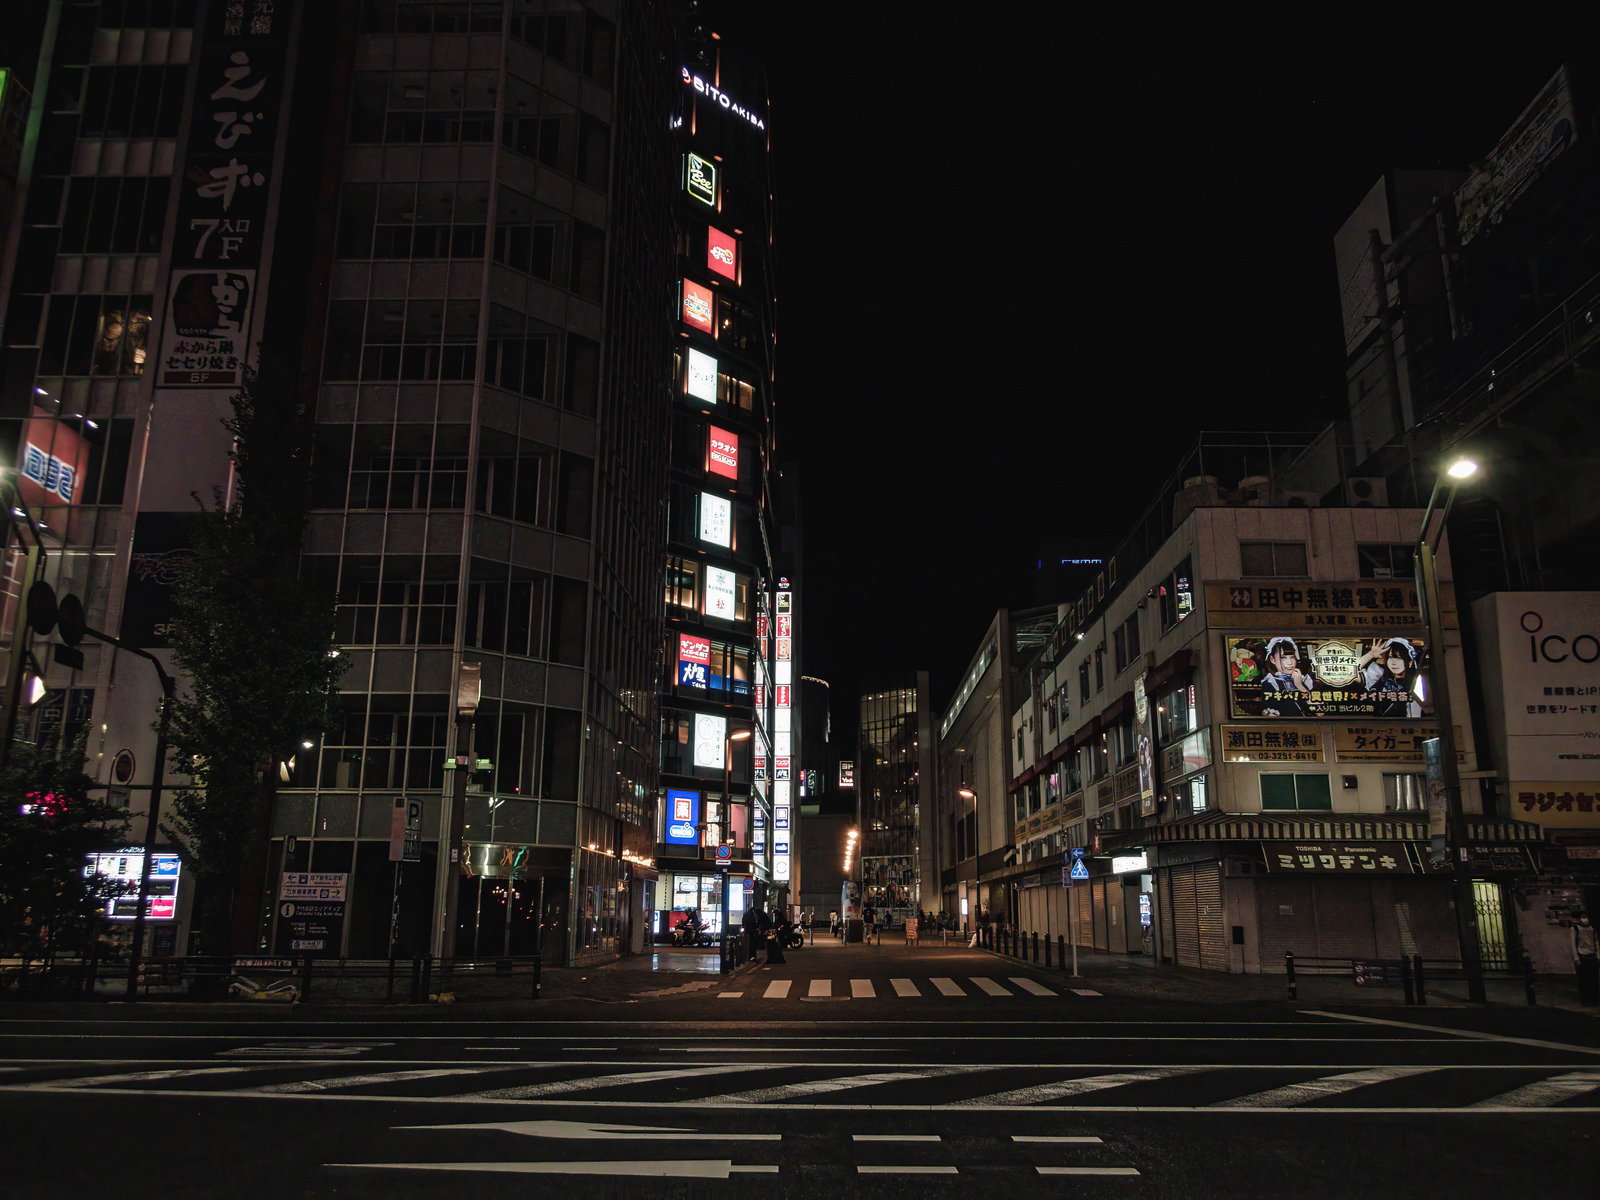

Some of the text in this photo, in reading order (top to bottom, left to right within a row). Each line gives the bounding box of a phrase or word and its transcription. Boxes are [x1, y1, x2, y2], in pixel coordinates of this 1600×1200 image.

[731, 102, 765, 130] AKIBA
[710, 440, 737, 454] カラオケ
[680, 640, 710, 653] ギンダコ
[1544, 687, 1600, 696] 無線機とIP
[1355, 735, 1438, 751] タイガー無
[409, 803, 419, 825] P
